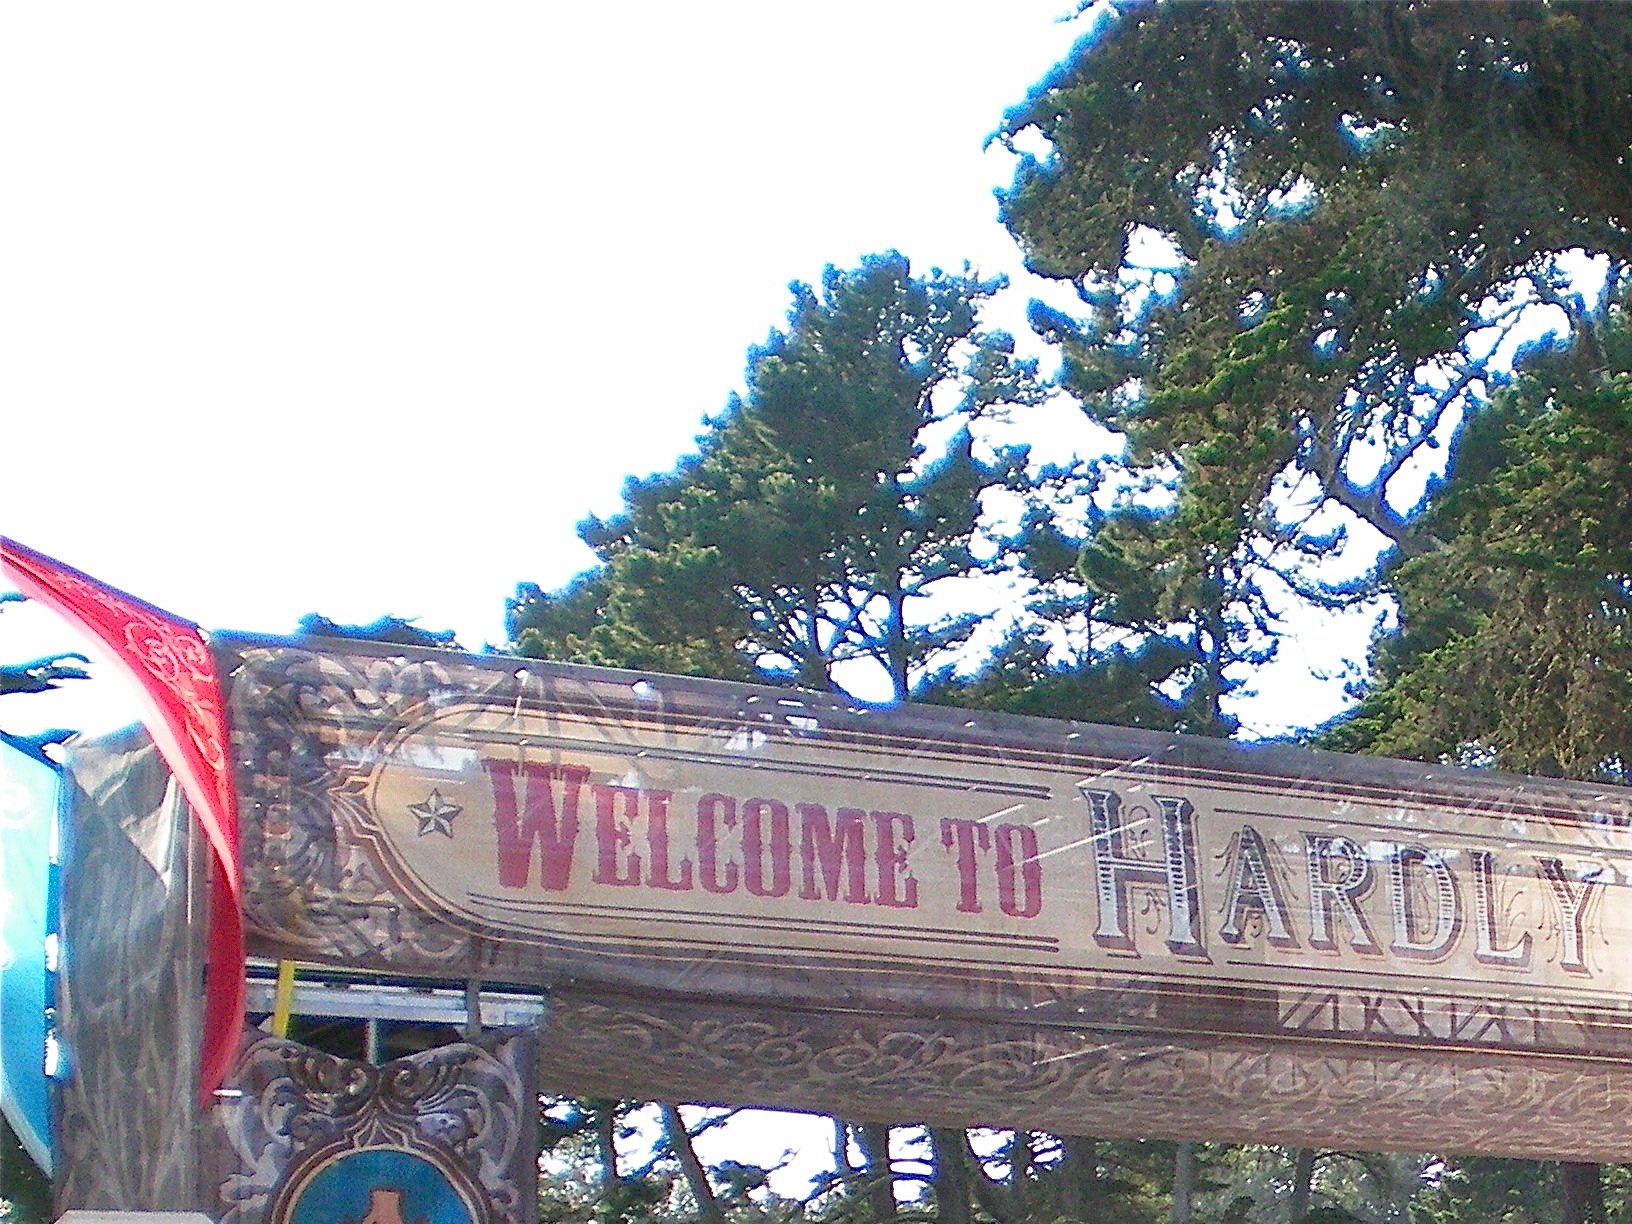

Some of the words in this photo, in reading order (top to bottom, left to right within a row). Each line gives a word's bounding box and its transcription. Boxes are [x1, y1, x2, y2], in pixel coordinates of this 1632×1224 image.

[481, 758, 920, 910] WELCOME
[940, 817, 1043, 918] TO
[1080, 784, 1600, 977] HARDLY
